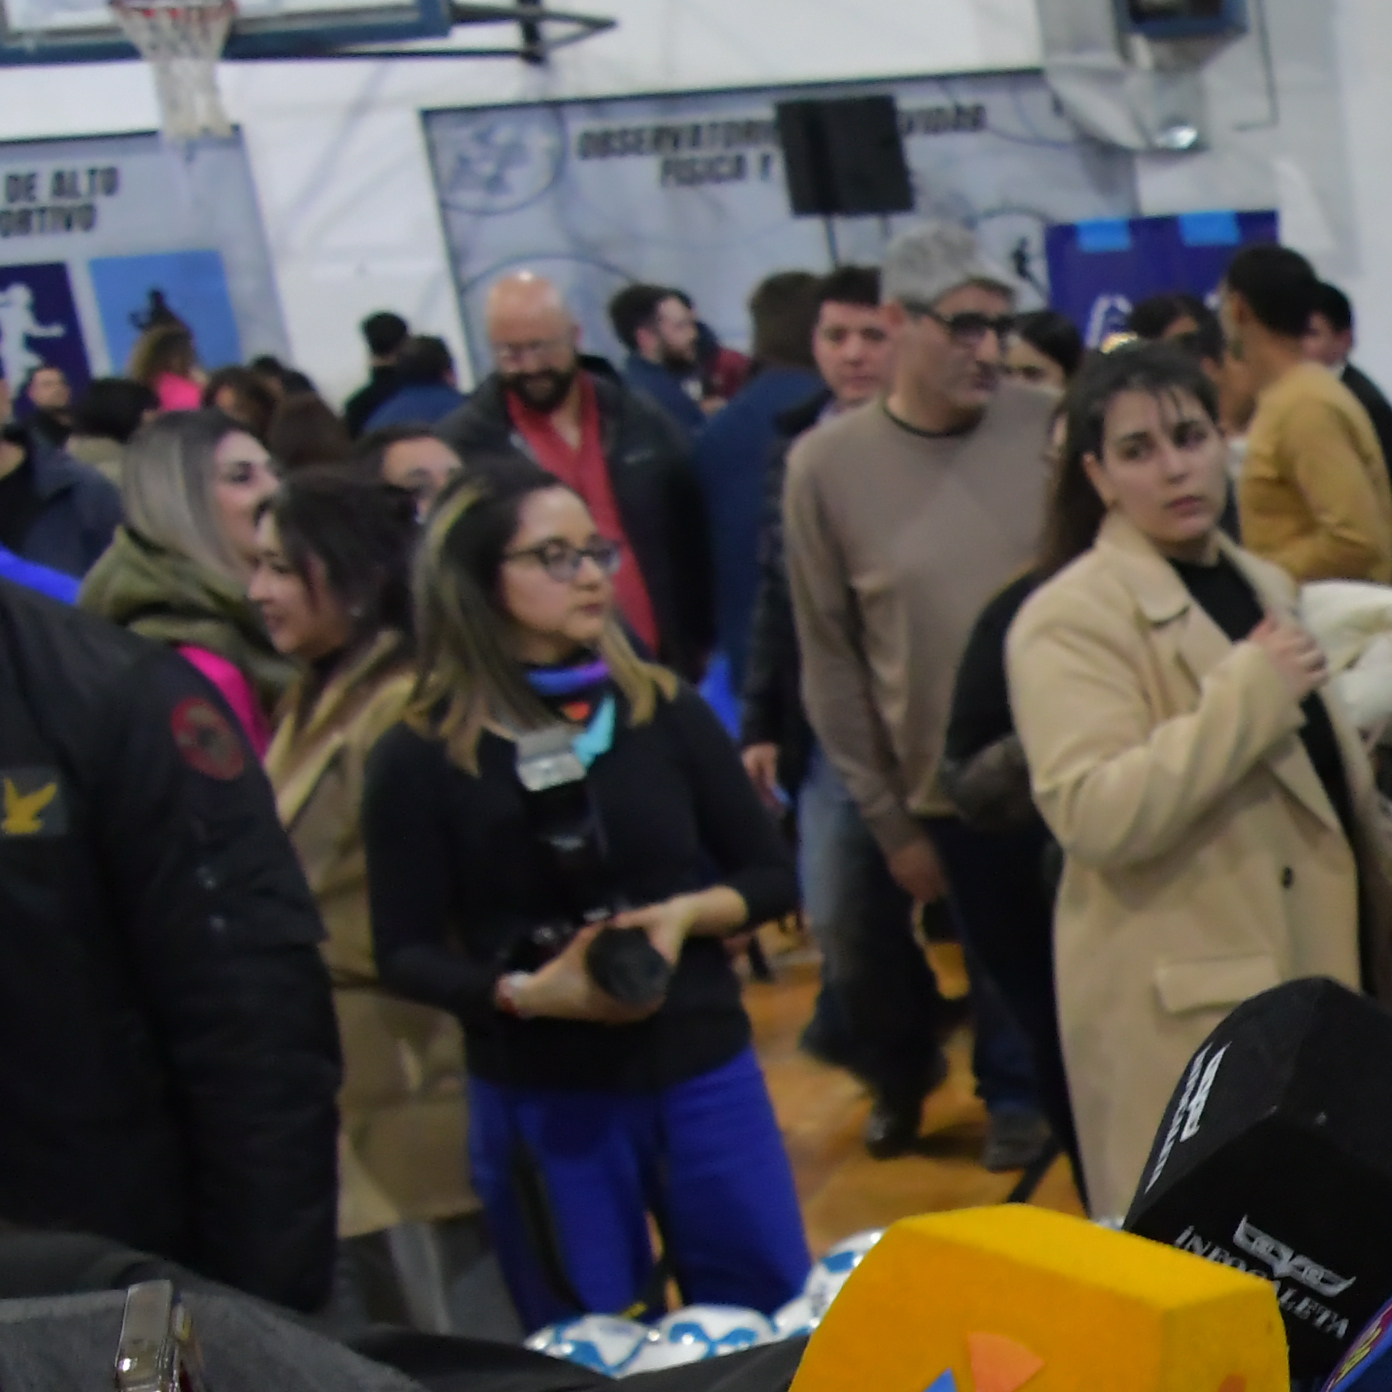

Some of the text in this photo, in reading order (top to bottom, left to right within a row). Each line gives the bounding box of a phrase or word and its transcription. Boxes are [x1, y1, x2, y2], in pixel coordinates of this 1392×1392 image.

[578, 117, 778, 161] OBSERVATORI
[6, 165, 120, 204] DE ALTO
